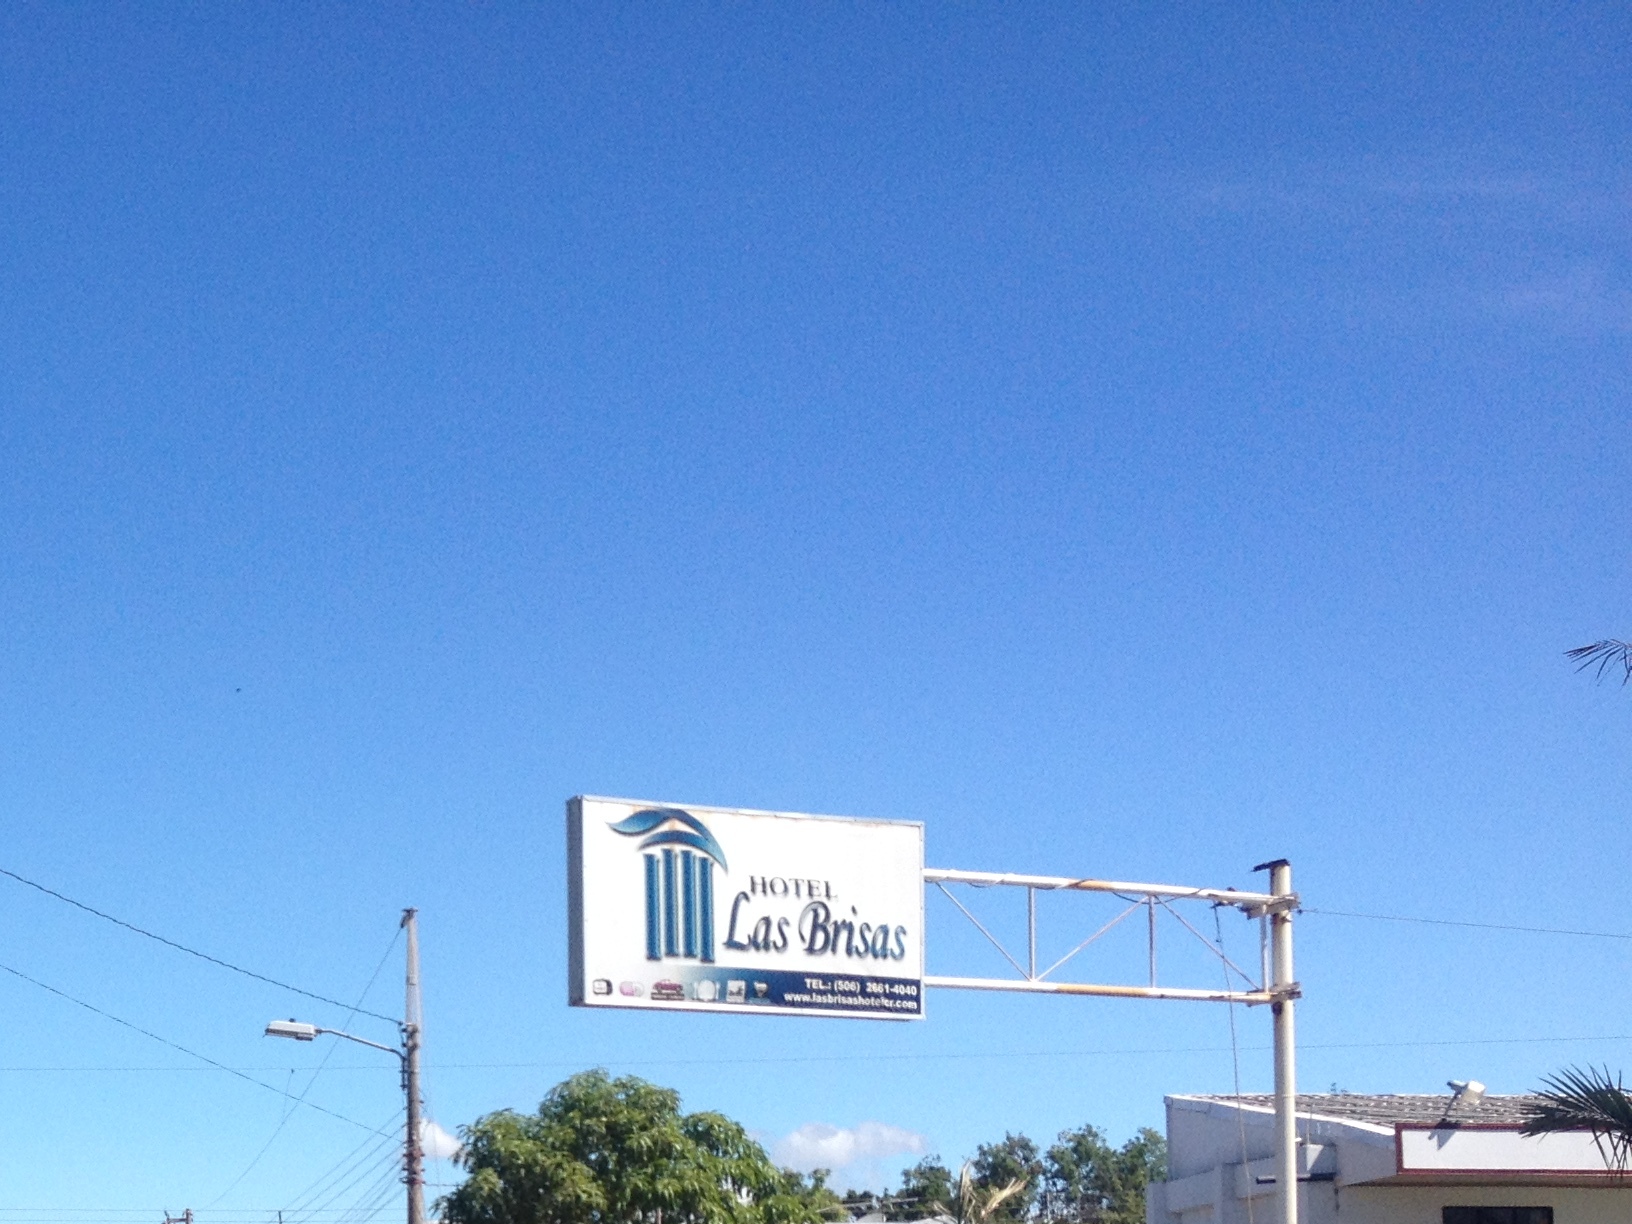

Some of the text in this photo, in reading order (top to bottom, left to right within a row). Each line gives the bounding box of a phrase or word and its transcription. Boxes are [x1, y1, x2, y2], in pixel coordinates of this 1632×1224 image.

[749, 875, 838, 901] HOTEL
[722, 891, 907, 960] Las Brisas
[834, 980, 861, 993] (506)
